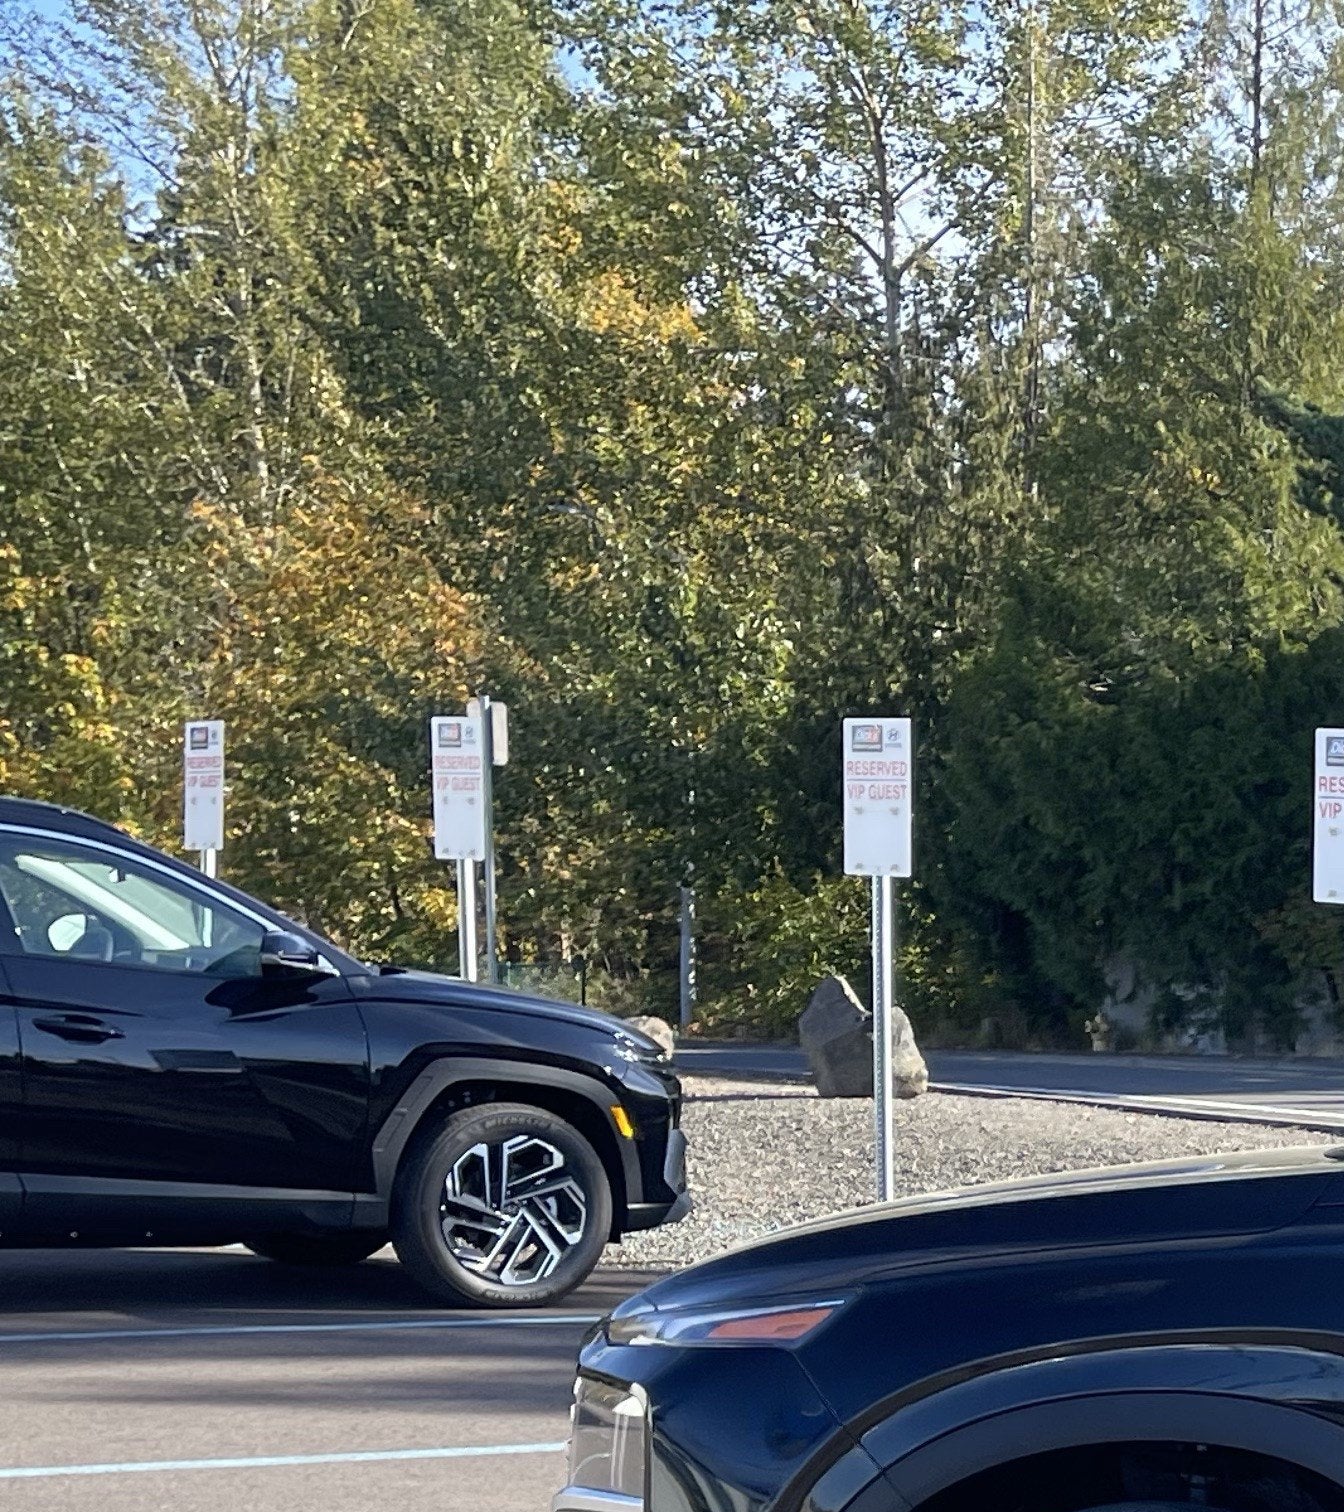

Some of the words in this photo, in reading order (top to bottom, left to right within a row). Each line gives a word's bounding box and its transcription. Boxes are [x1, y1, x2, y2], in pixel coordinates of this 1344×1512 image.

[846, 760, 908, 776] RESERVED
[846, 784, 865, 800] VIP
[868, 784, 907, 800] GUEST
[1318, 801, 1342, 819] VIP
